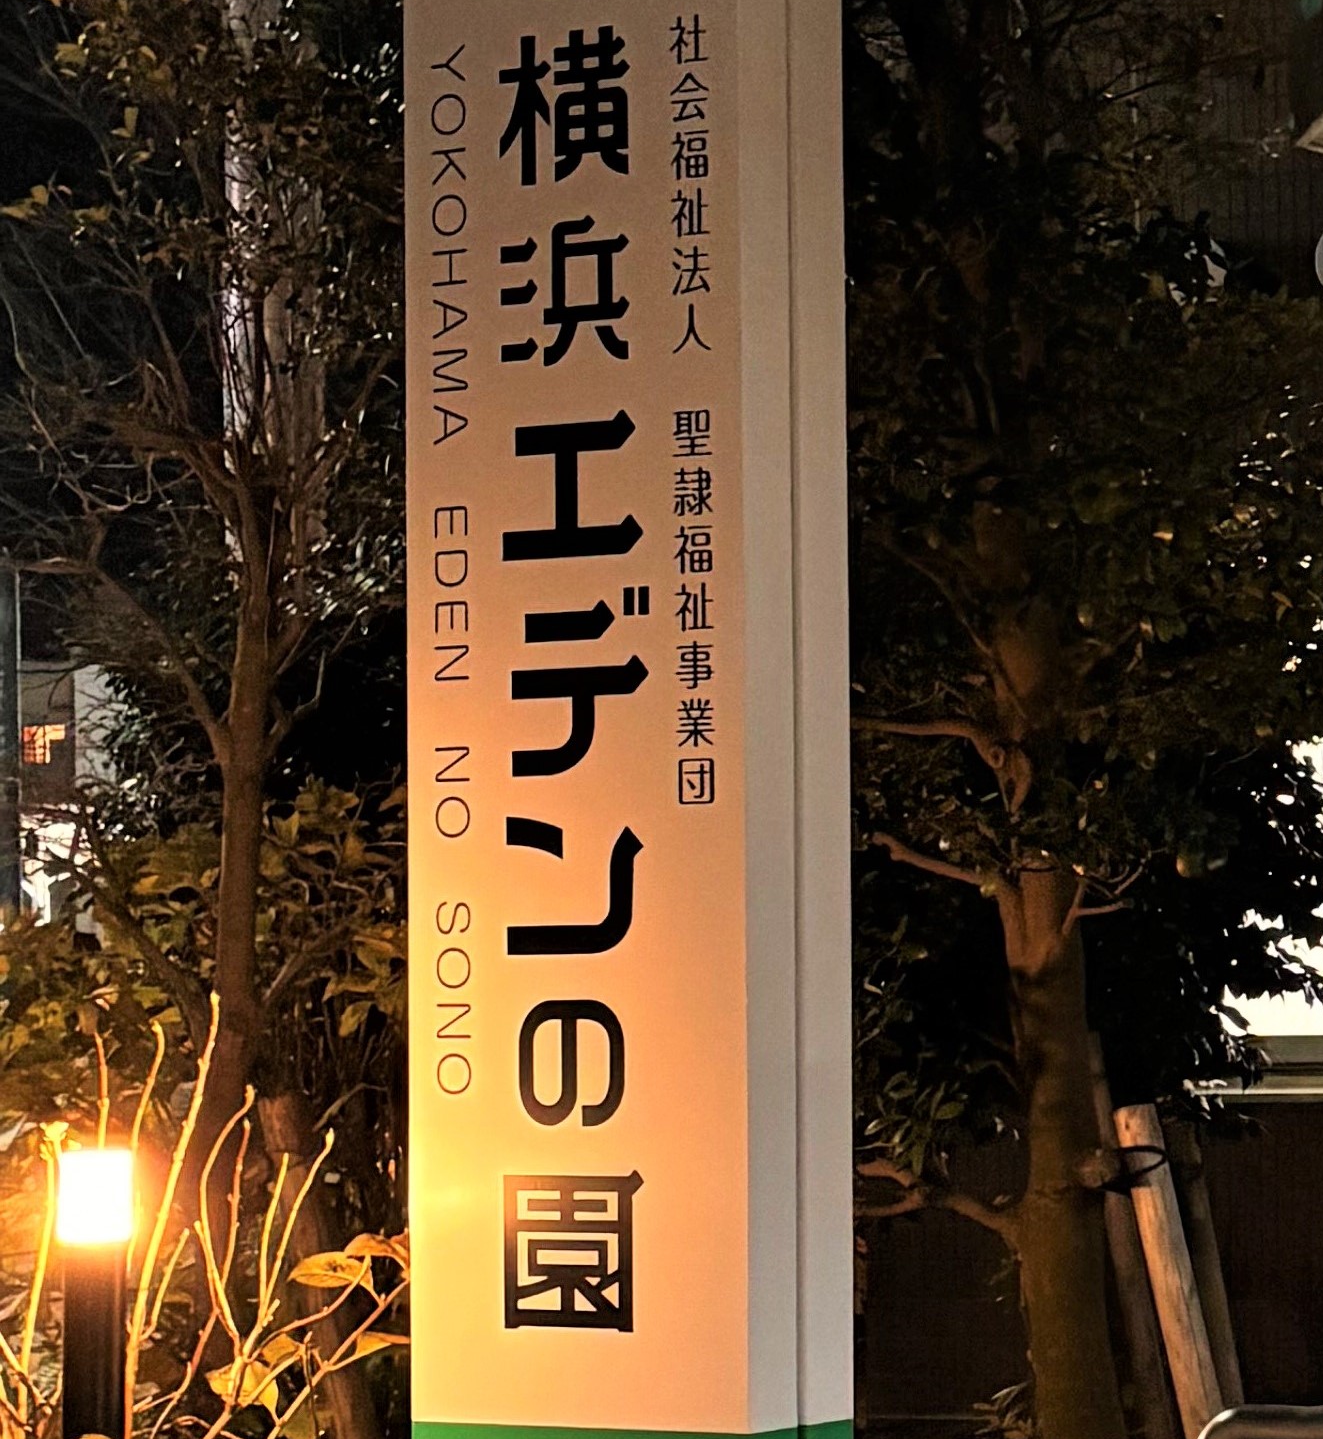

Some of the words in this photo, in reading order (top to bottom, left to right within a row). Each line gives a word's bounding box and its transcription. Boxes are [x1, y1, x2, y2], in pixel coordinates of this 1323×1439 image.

[431, 43, 468, 446] YOKOHAMA
[669, 14, 712, 354] 社会福祉法人
[434, 505, 469, 682] EDEN
[499, 25, 650, 1332] 横浜エデンの園
[673, 410, 715, 805] 聖隷福祉事業団
[435, 746, 470, 838] NO
[436, 901, 471, 1095] SONO
